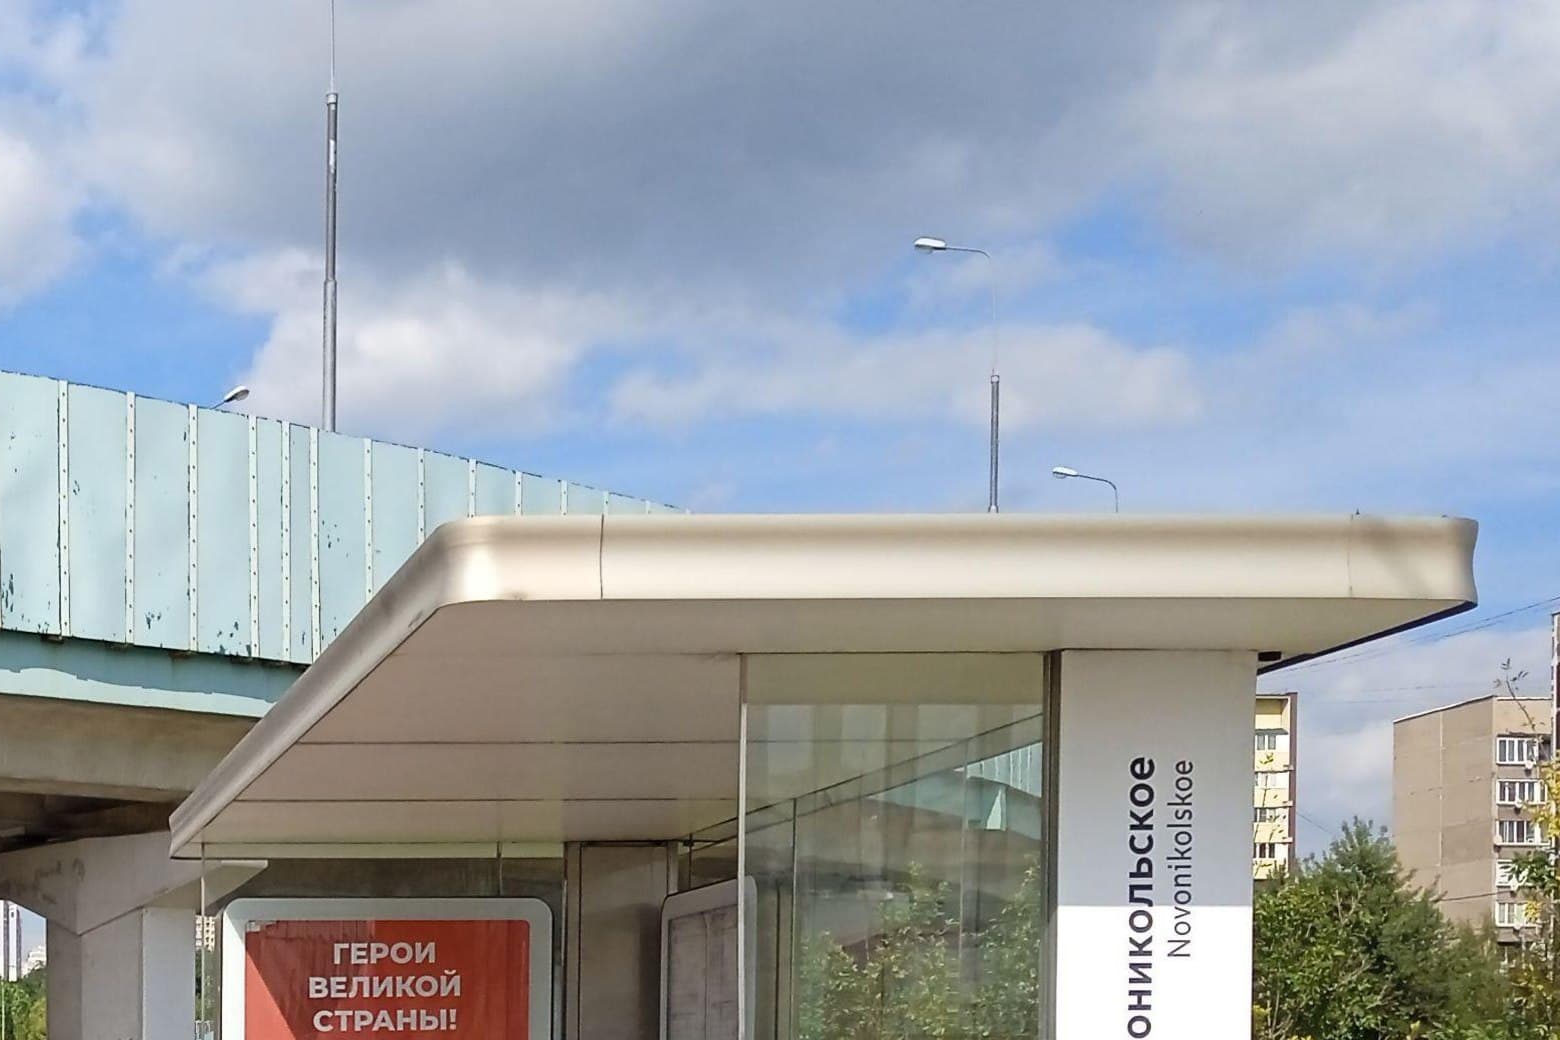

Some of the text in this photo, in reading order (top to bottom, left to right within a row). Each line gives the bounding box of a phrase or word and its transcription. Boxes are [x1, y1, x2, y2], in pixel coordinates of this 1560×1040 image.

[1166, 759, 1195, 958] Novonikolskoe
[333, 942, 436, 965] ГЕРОИ
[308, 969, 461, 998] ВЕЛИКОЙ
[313, 1009, 458, 1033] СТРАНЫ!
